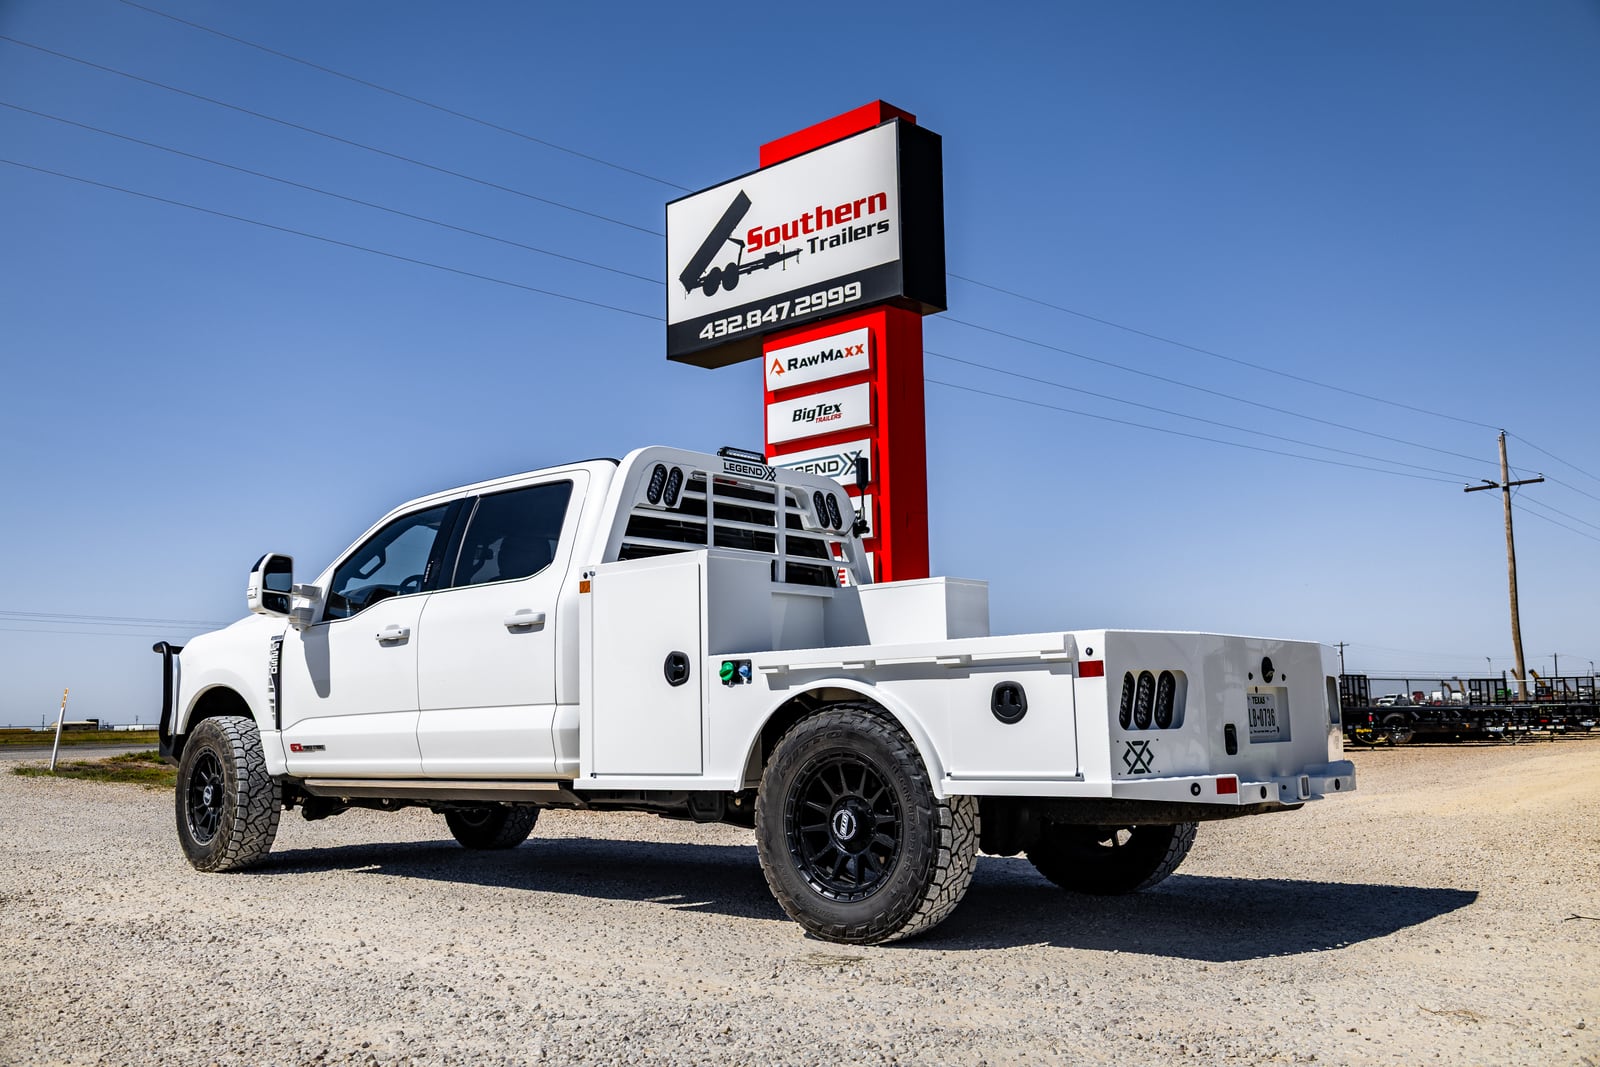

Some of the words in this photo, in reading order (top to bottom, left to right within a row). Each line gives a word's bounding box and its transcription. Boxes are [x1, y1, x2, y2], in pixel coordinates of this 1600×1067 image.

[747, 191, 887, 253] Southern
[807, 219, 890, 254] Trailers
[699, 281, 862, 340] 432.847.2999
[1251, 696, 1266, 704] TEXAS
